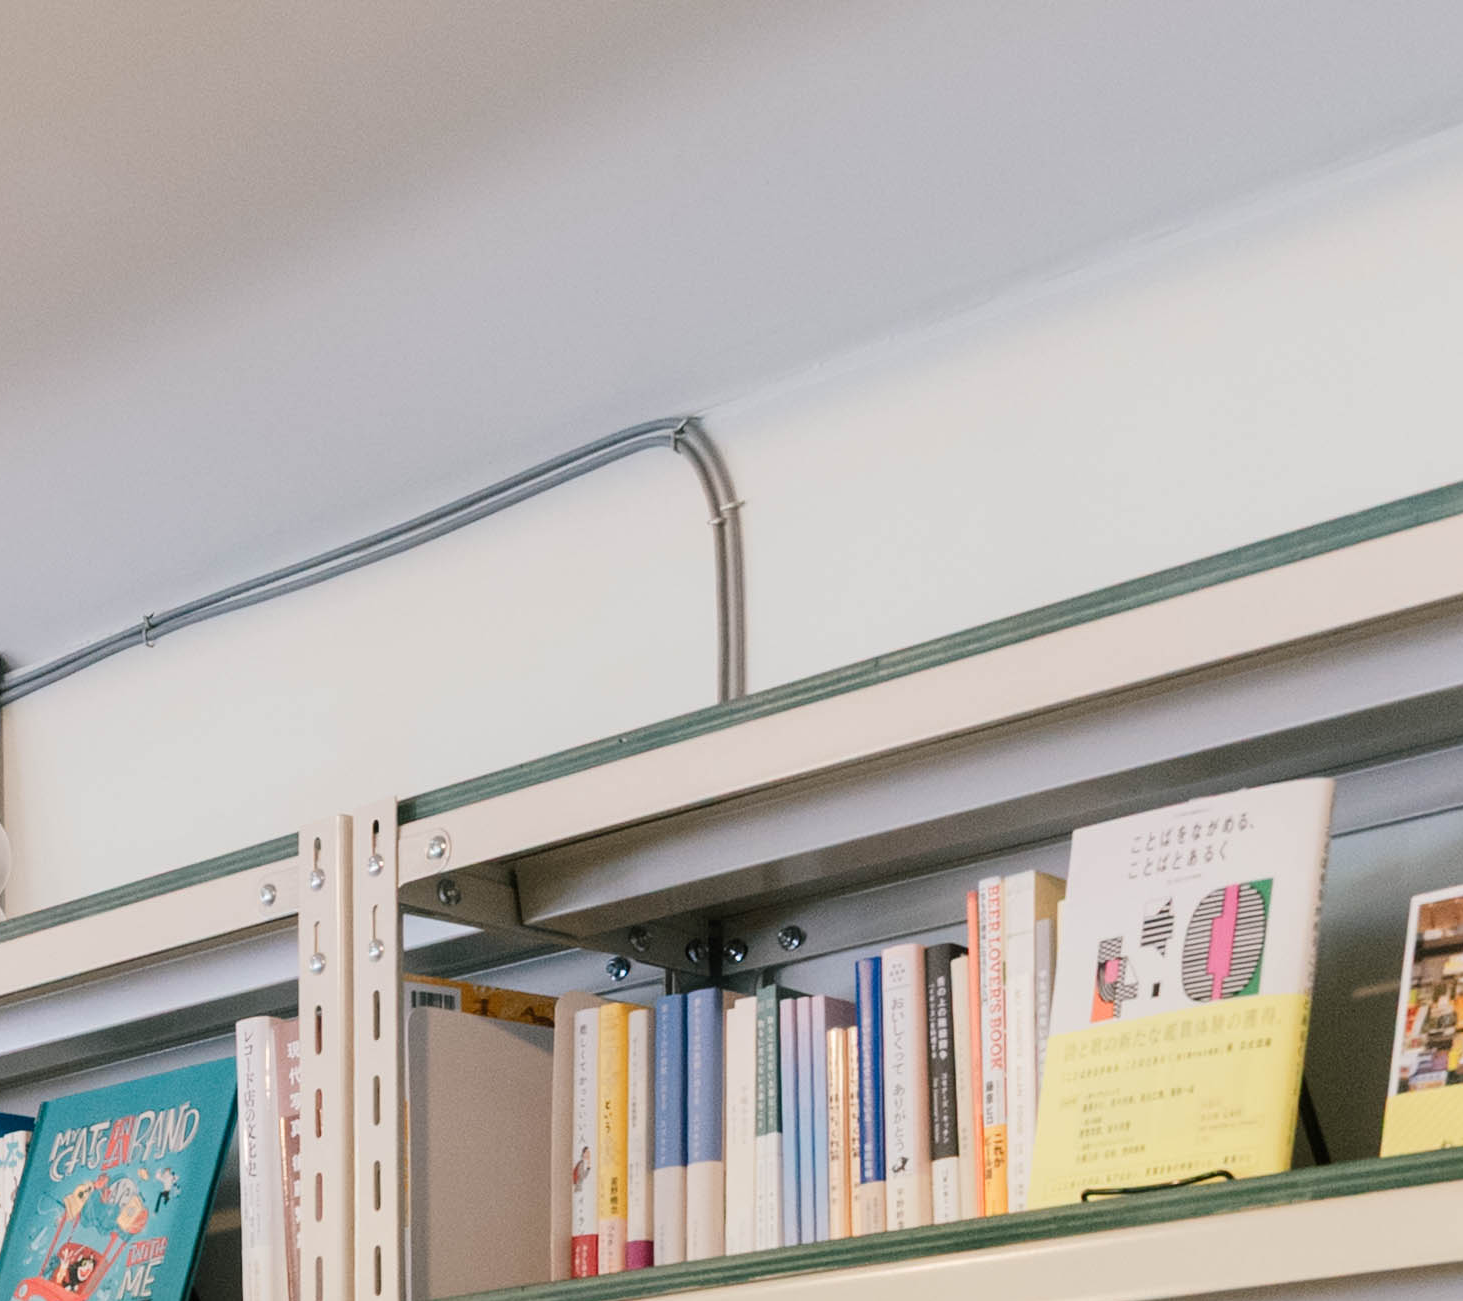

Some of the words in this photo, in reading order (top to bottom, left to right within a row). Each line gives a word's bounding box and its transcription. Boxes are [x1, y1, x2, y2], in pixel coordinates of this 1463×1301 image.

[1131, 812, 1255, 853] ことばをながめる、
[1129, 841, 1228, 879] ことばとあるく
[987, 884, 1001, 940] BEER
[988, 943, 1003, 1018] LOVER'S
[890, 997, 906, 1077] おいしくって
[989, 1022, 1004, 1071] BOOK
[891, 1084, 906, 1153] ありがとう
[117, 1257, 165, 1300] ME
